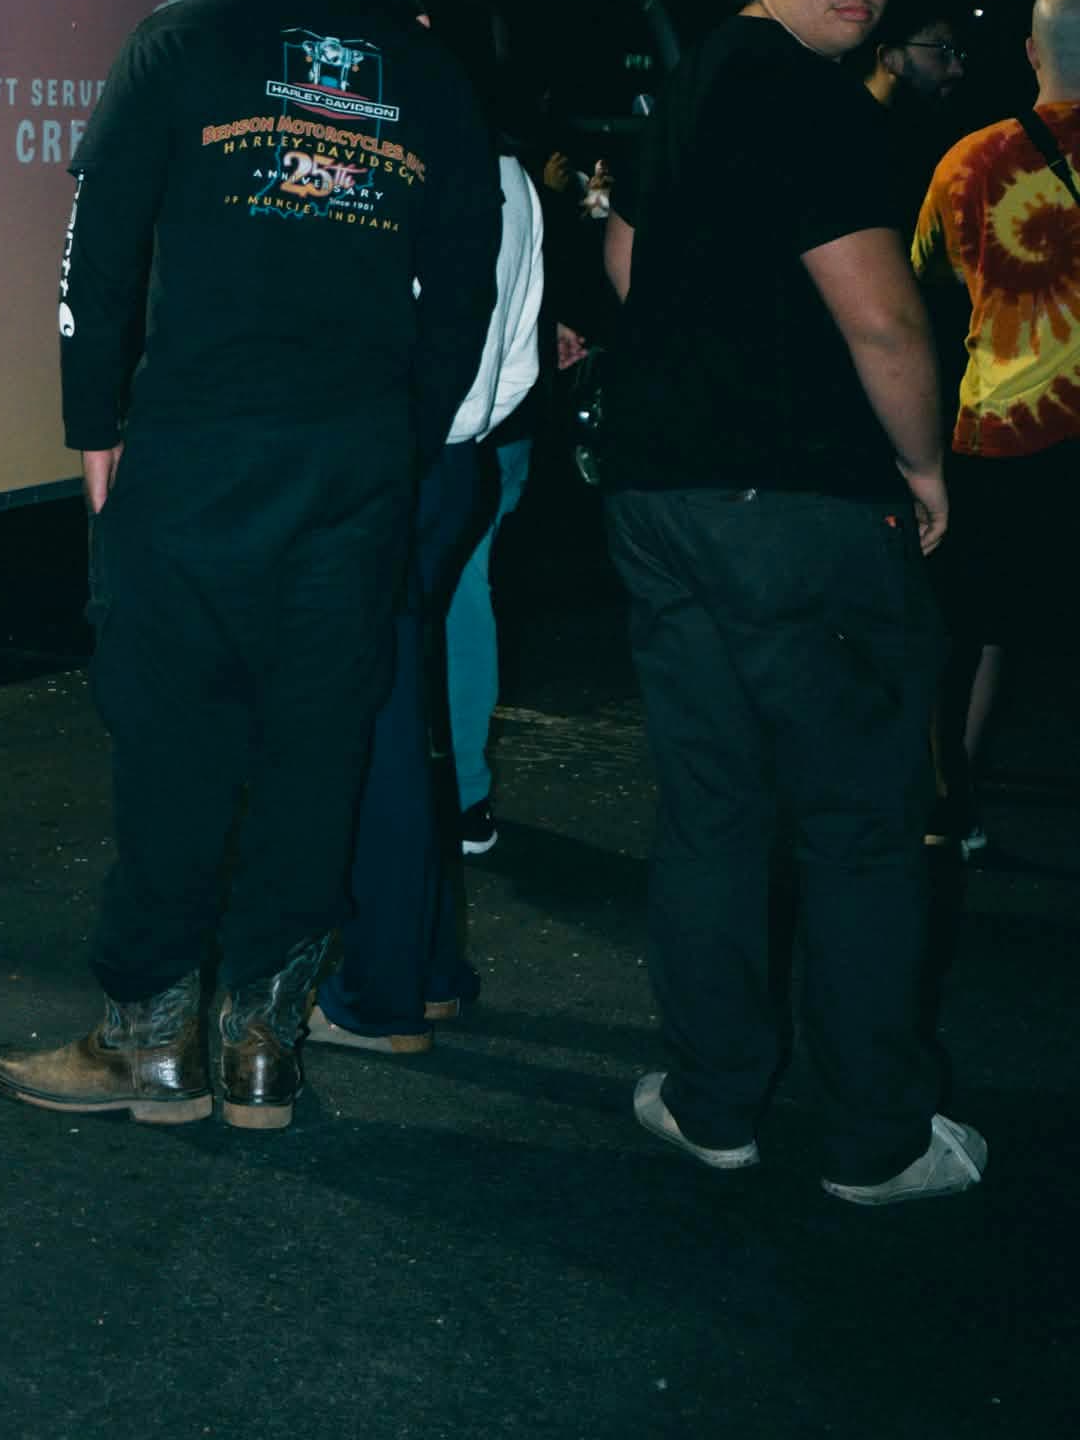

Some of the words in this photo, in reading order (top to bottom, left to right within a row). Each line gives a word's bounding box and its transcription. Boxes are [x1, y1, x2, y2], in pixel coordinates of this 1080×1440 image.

[271, 84, 395, 117] HARLEY-DAVIDSON
[15, 118, 88, 165] CRE
[202, 116, 275, 147] BENSON
[253, 168, 384, 200] ANNIVERSARY
